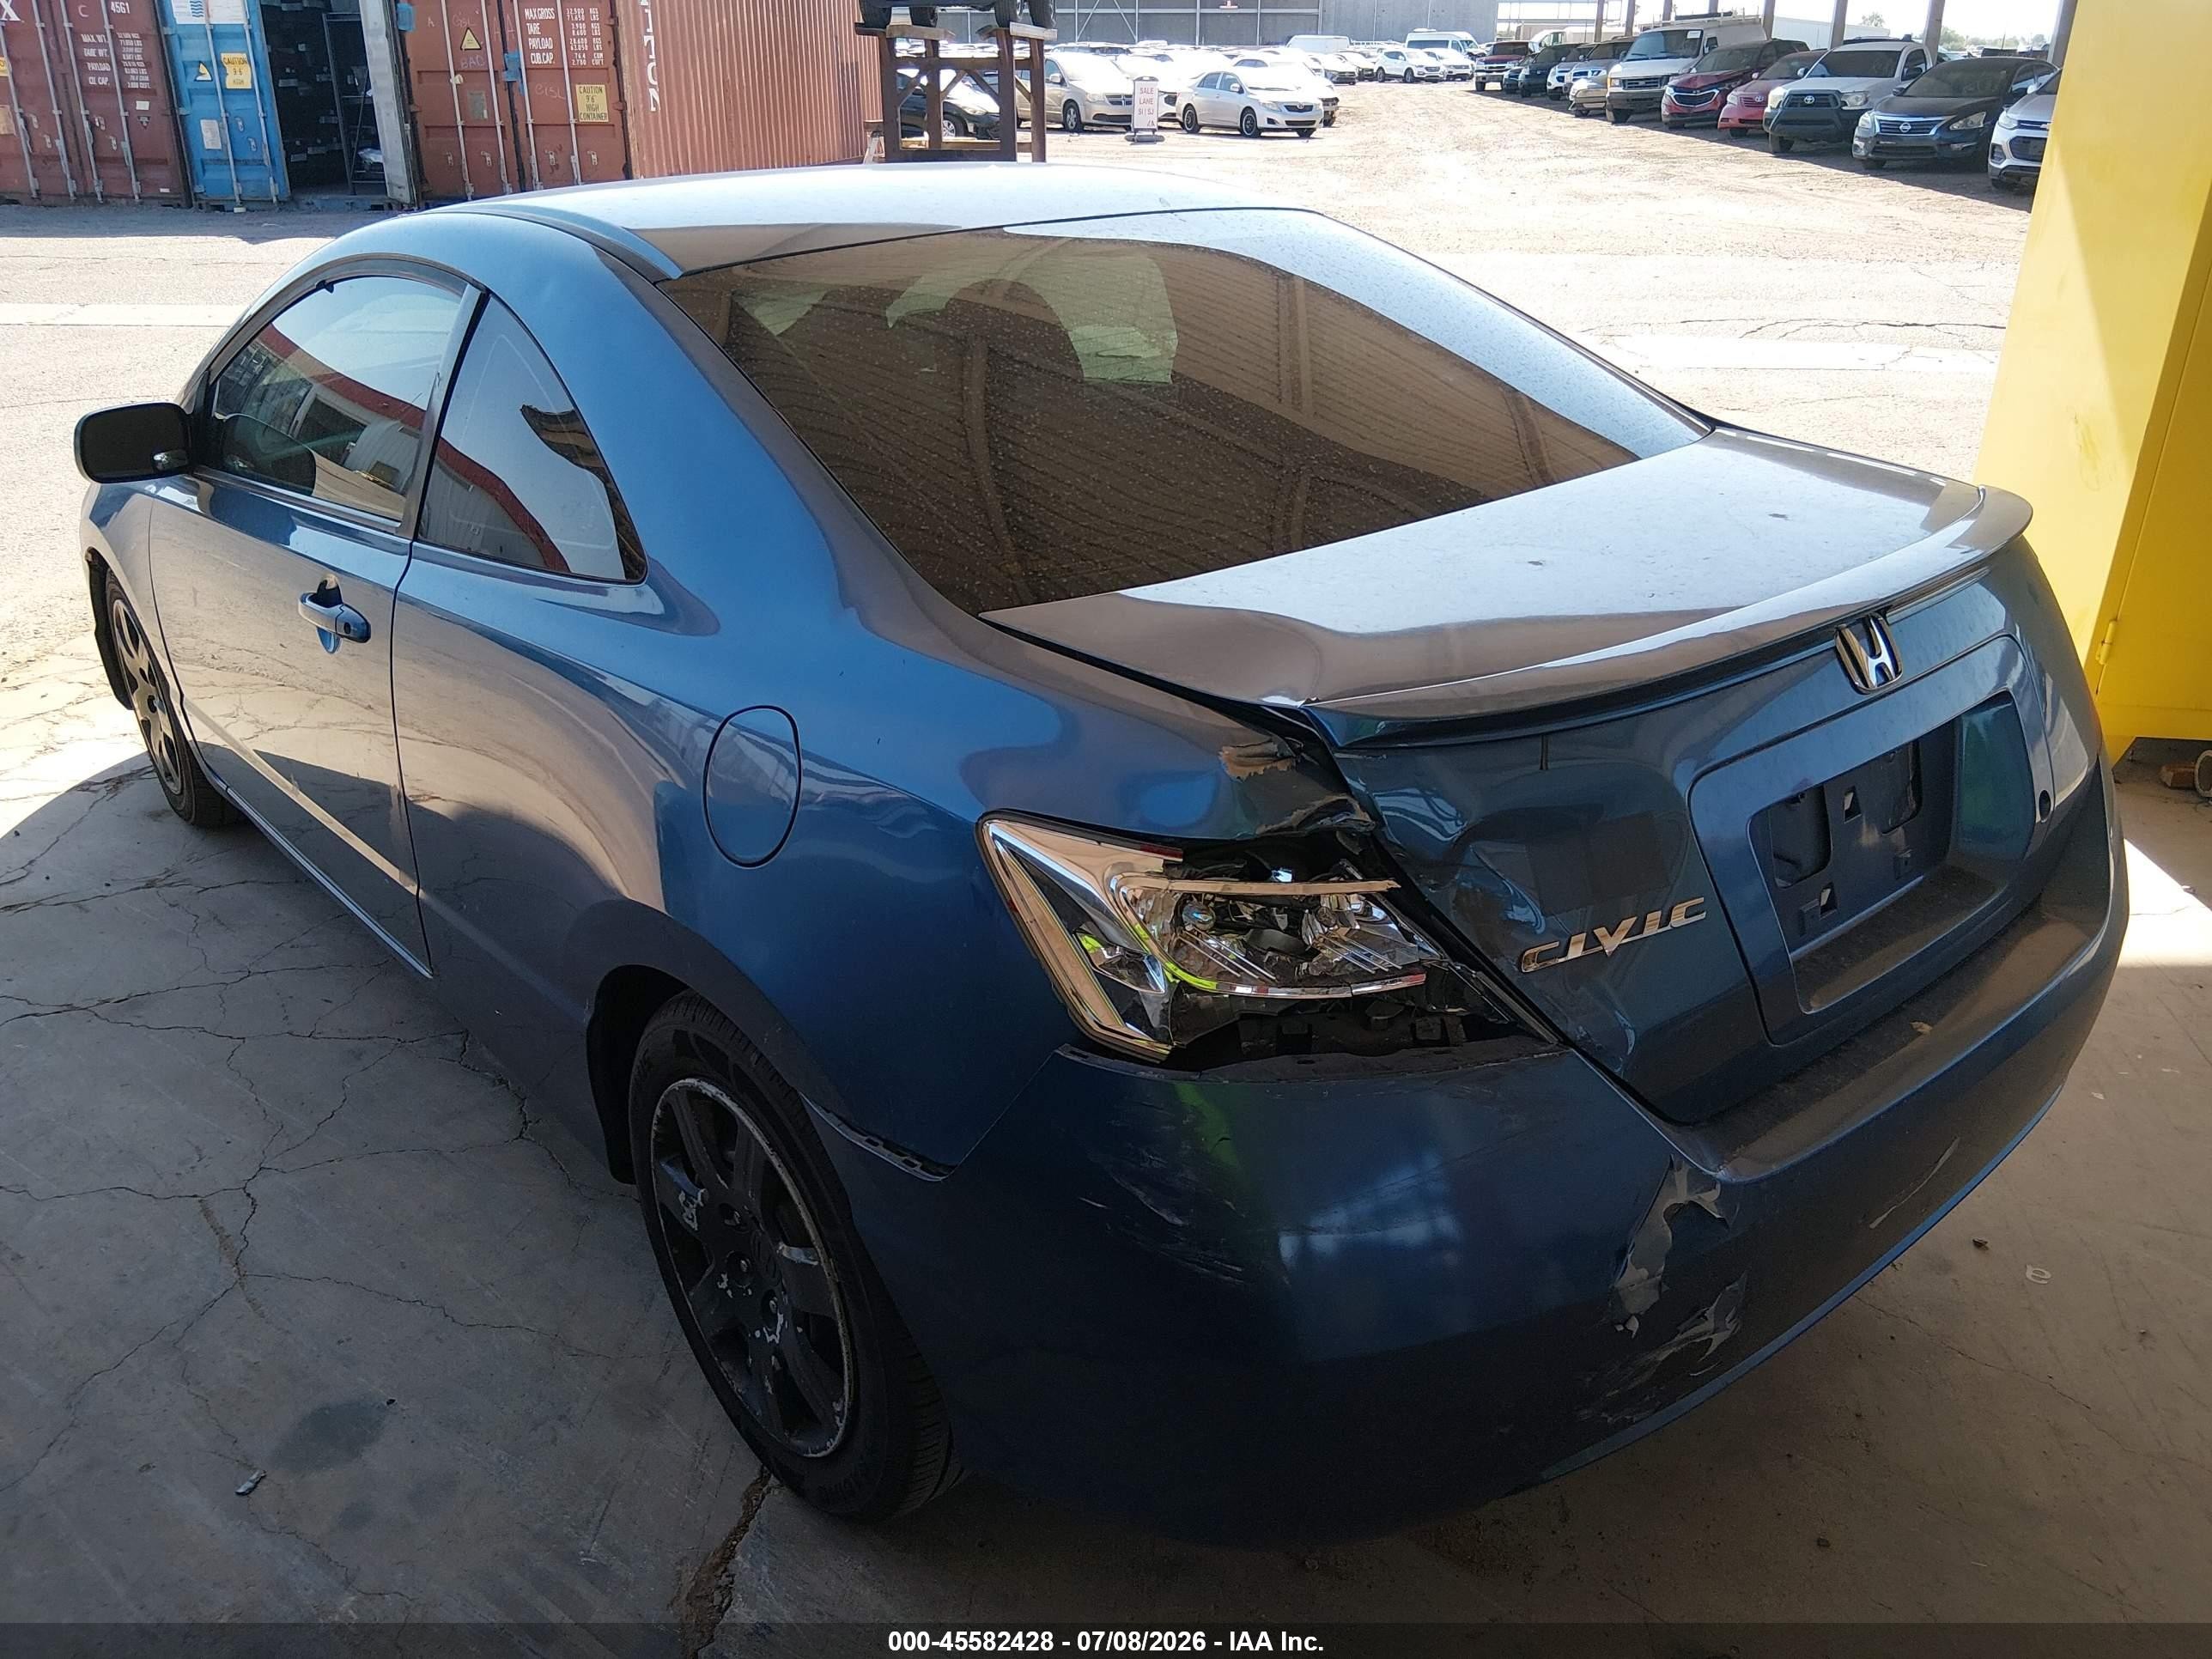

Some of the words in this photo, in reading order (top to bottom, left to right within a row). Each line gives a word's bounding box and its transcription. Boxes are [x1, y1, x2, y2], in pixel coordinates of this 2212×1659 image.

[526, 23, 542, 34] TARE
[528, 37, 553, 50] PAYLOAD
[87, 62, 112, 71] PAYLOAD
[586, 103, 599, 112] HIGH
[580, 112, 607, 121] CONTAINER
[1521, 896, 1707, 973] CIVIC
